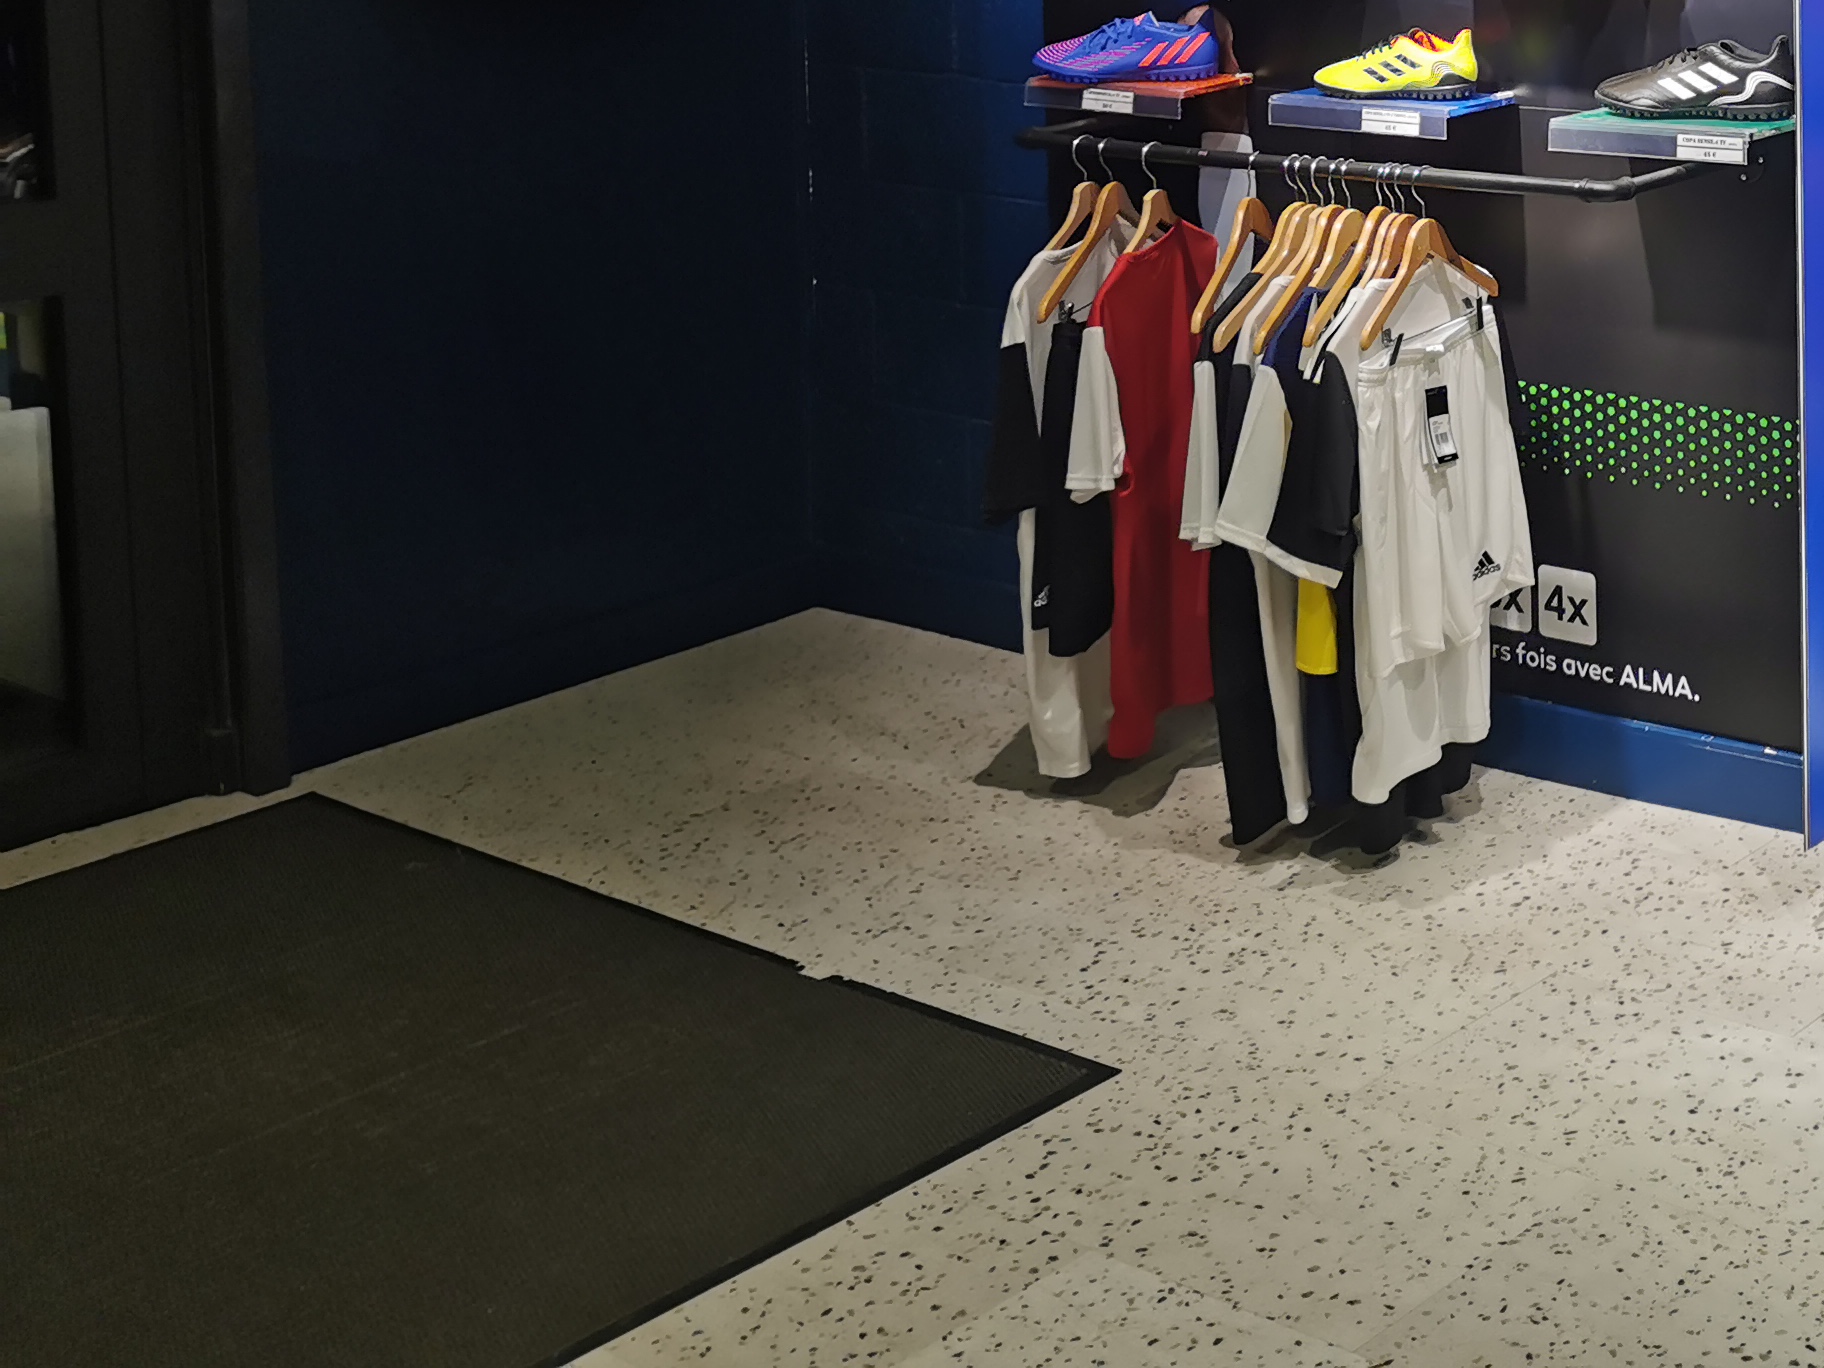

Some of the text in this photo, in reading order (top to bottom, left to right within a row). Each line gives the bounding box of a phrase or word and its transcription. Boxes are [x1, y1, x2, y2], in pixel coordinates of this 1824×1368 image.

[1490, 585, 1589, 627] x 4x
[1515, 642, 1557, 672] fois
[1562, 658, 1614, 684] avec
[1619, 664, 1701, 702] ALMA.
